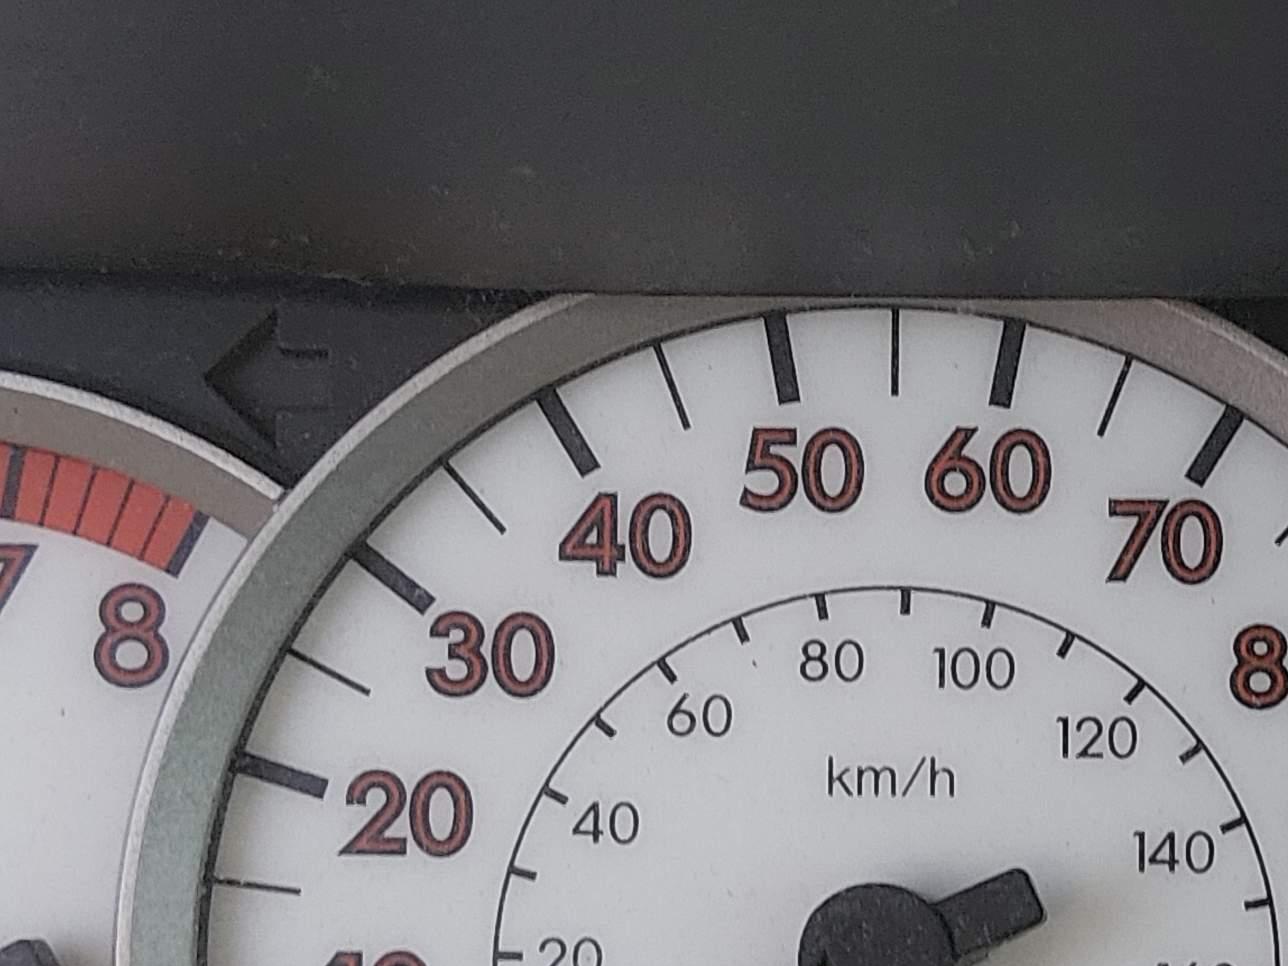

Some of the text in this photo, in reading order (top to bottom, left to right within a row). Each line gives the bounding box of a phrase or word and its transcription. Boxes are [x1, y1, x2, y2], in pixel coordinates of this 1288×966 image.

[740, 427, 864, 513] 50
[925, 426, 1051, 515] 60
[559, 492, 692, 579] 40
[1106, 498, 1223, 585] 70
[94, 582, 169, 689] 8
[425, 611, 555, 698] 30
[800, 640, 863, 682] 80
[934, 648, 1014, 690] 100
[667, 693, 732, 737] 60
[1057, 717, 1137, 759] 120
[828, 756, 954, 797] km/h
[340, 770, 473, 858] 20
[573, 802, 639, 844] 40
[1134, 831, 1214, 873] 140
